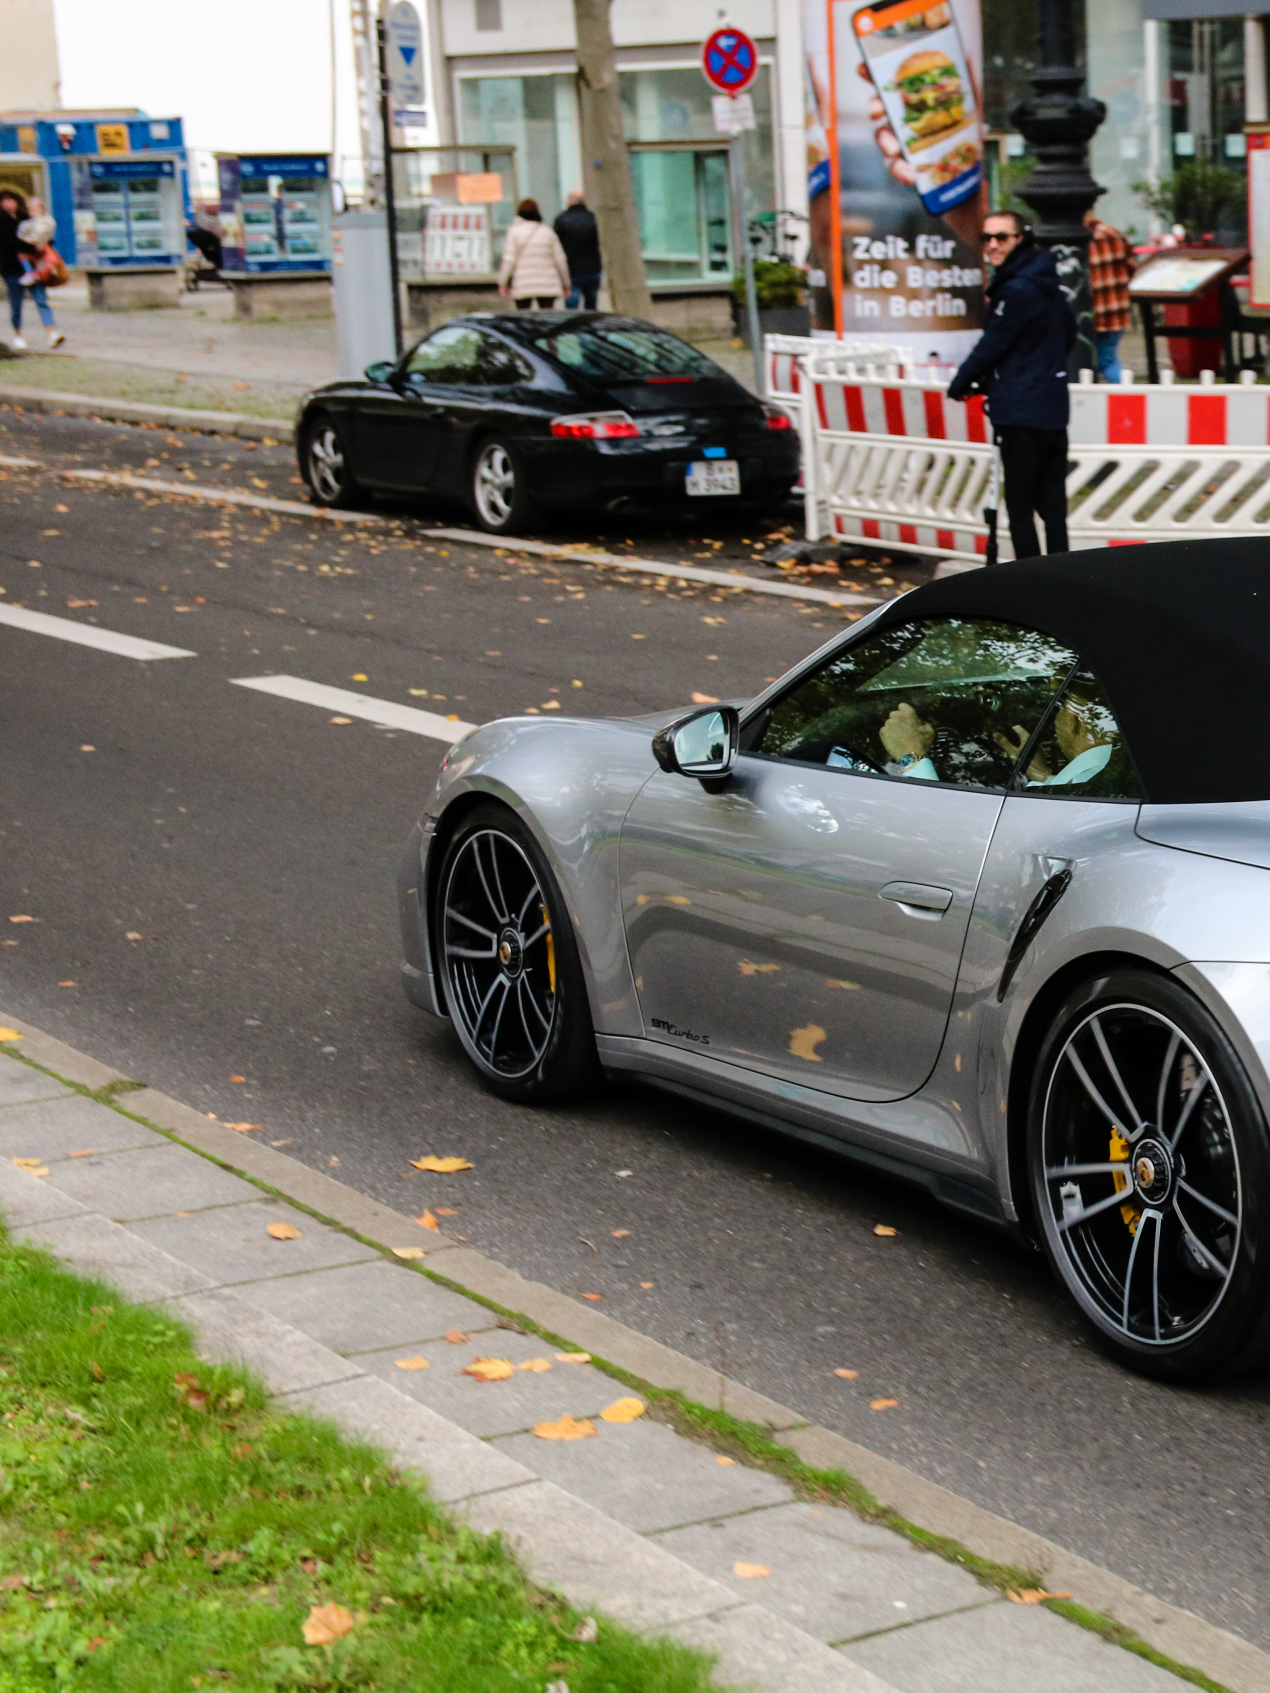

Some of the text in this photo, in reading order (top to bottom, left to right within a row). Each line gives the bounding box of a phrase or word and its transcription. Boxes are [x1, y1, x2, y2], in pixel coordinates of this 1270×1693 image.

[852, 234, 957, 260] Zeit für
[853, 264, 898, 288] die
[907, 265, 983, 288] Besten
[855, 293, 967, 317] in Berlin
[699, 1035, 710, 1045] S
